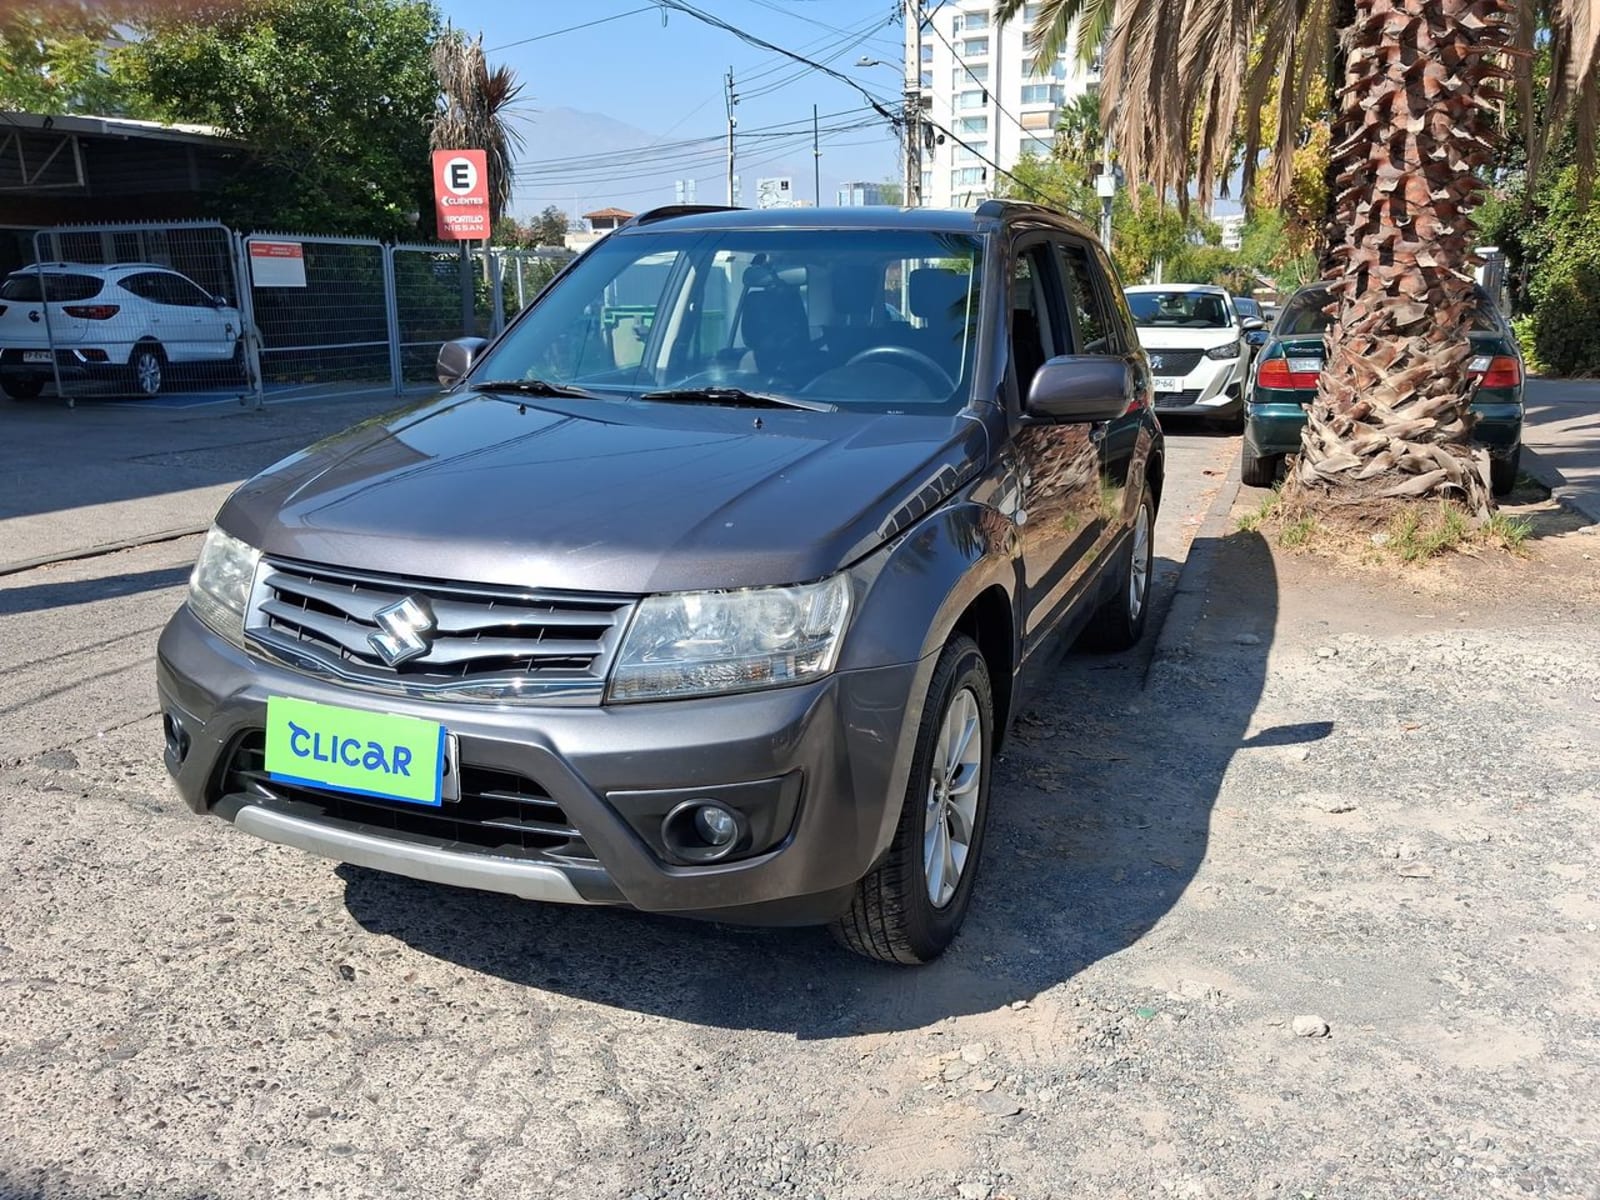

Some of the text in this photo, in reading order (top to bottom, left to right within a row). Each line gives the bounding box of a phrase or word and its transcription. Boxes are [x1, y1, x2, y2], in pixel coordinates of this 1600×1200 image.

[451, 164, 470, 189] E
[448, 196, 484, 206] CLIENTES
[444, 224, 484, 232] NISSAN
